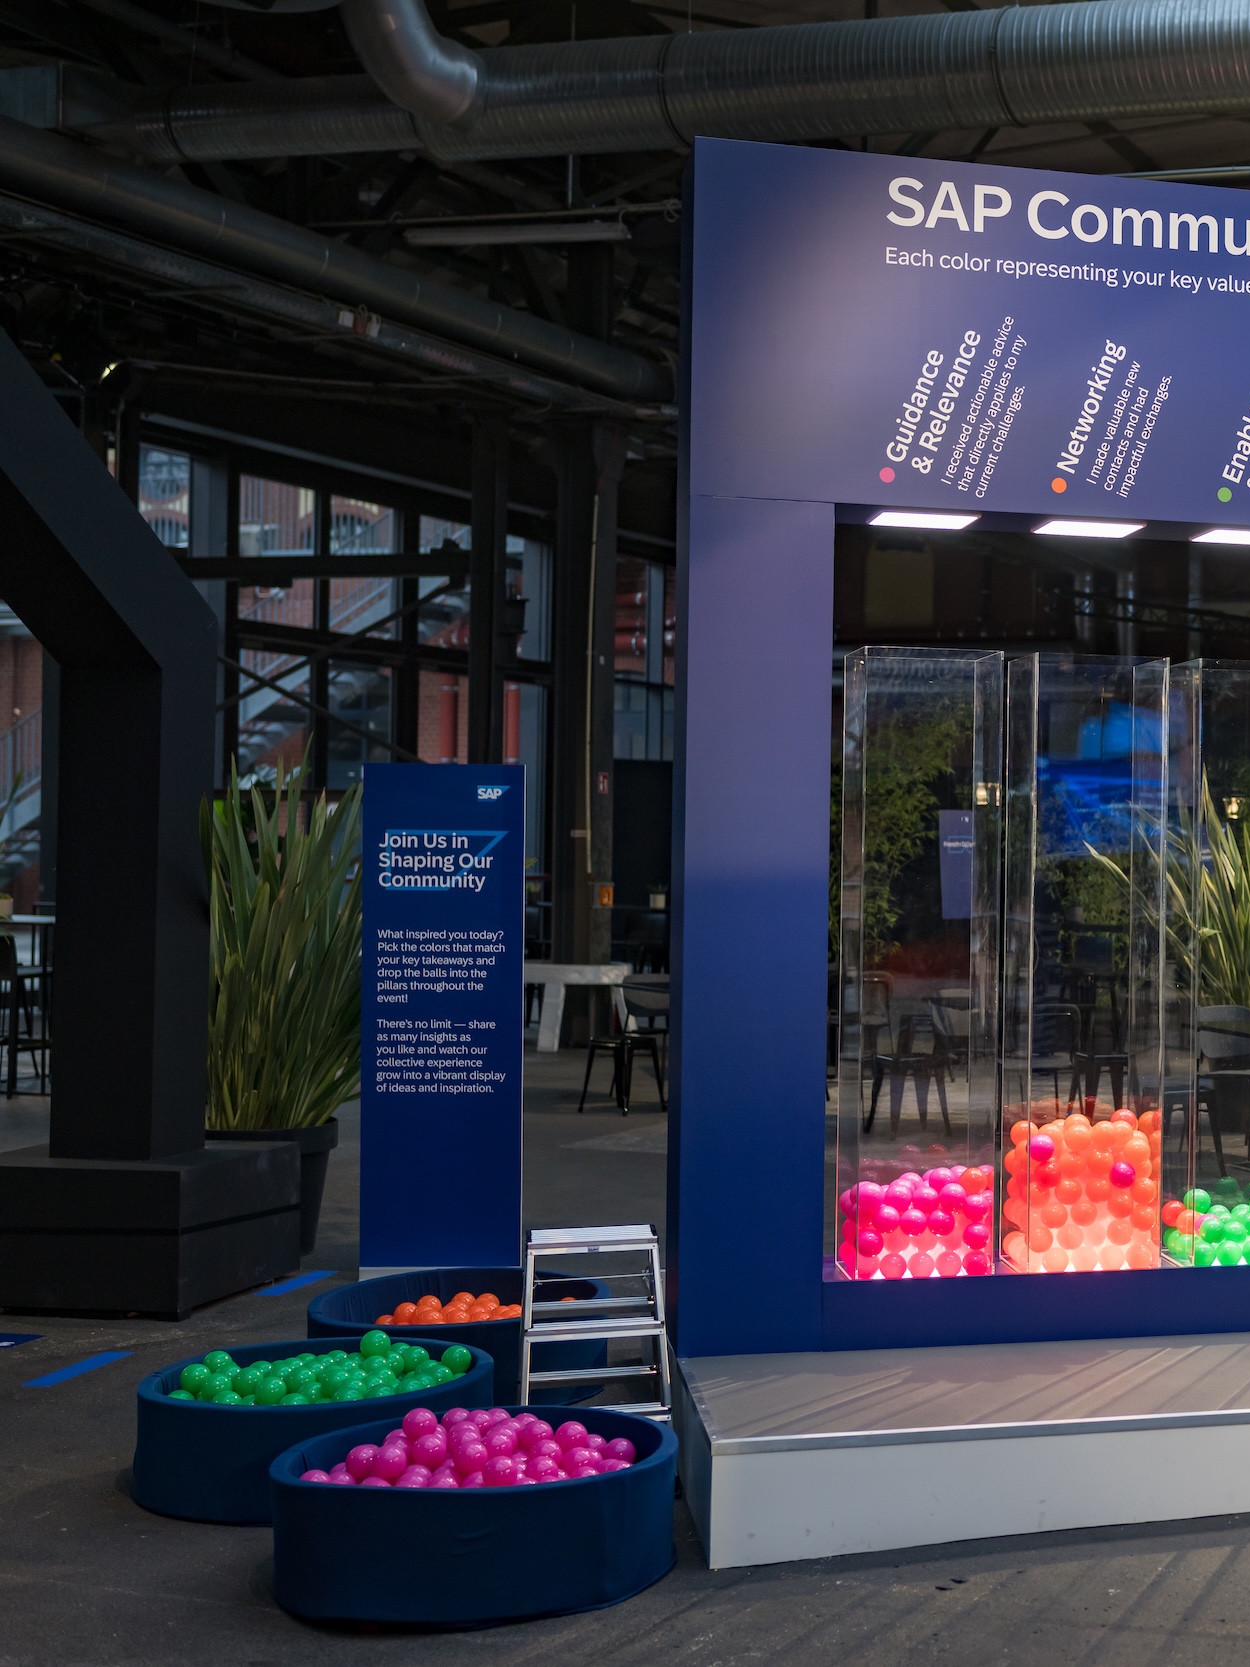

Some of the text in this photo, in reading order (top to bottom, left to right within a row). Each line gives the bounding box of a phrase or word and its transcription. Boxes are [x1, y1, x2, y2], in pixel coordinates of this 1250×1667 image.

[887, 177, 1012, 232] SAP
[886, 247, 933, 267] Each
[940, 253, 991, 271] color
[997, 260, 1118, 287] representing
[1122, 270, 1165, 288] your
[1170, 270, 1203, 294] key
[886, 350, 943, 461] Guidance
[911, 330, 980, 473] & Relevance
[945, 316, 1013, 478] received actionable advice
[957, 334, 1027, 491] that directly applies to my
[1056, 339, 1126, 474] Networking
[1090, 360, 1140, 478] made valuable new
[975, 386, 1025, 497] current challenges.
[1103, 386, 1148, 490] contacts and had
[1116, 375, 1172, 497] impactful exchanges.
[477, 788, 503, 800] SAP
[379, 831, 467, 848] Join Us in
[378, 852, 493, 872] Shaping Our
[378, 872, 485, 892] Community
[377, 929, 503, 941] What inspired you today?
[377, 941, 505, 952] Pick the colors that match
[377, 954, 495, 967] your key takeaways and
[377, 967, 487, 978] drop the balls into the
[377, 980, 483, 992] pillars throughout the
[376, 993, 407, 1002] event!
[376, 1018, 412, 1028] There's
[430, 1018, 451, 1028] limit
[468, 1019, 495, 1029] share
[376, 1033, 388, 1041] as
[390, 1033, 417, 1043] many
[420, 1031, 457, 1043] insights
[376, 1044, 487, 1056] you like and watch our
[376, 1057, 482, 1068] collective experience
[376, 1070, 505, 1082] grow into vibrant display
[376, 1082, 493, 1094] of ideas and inspiration.
